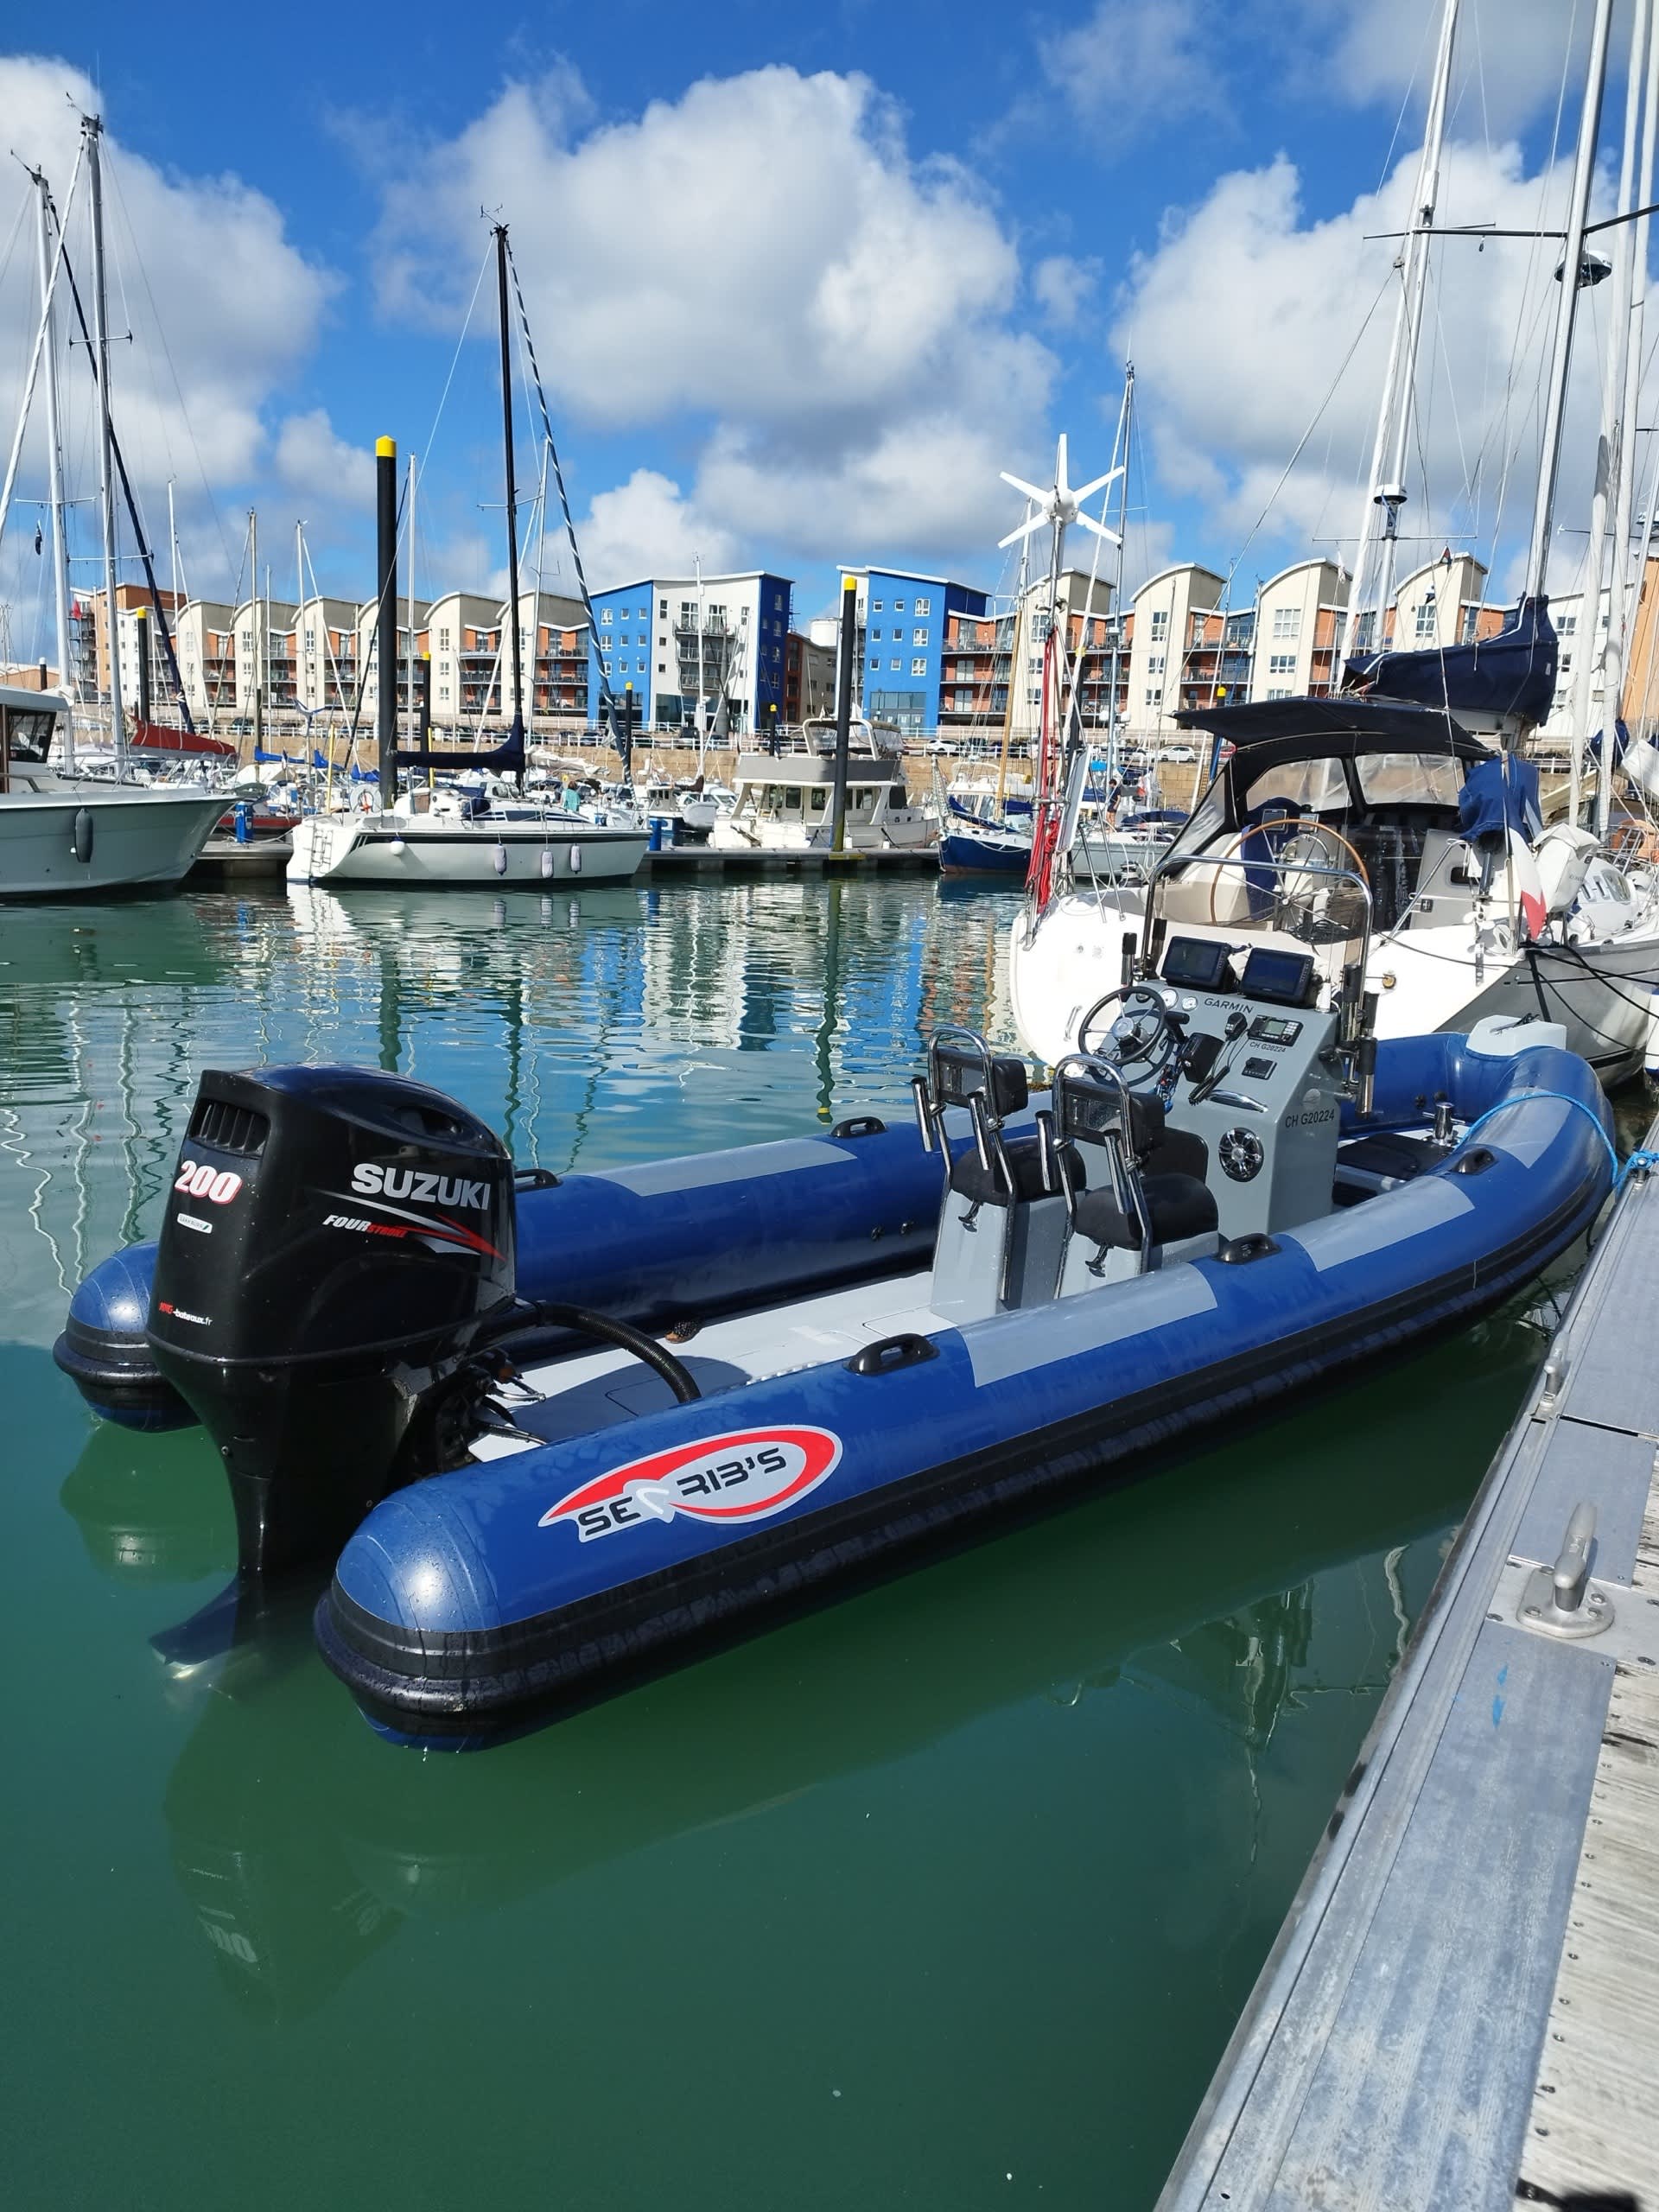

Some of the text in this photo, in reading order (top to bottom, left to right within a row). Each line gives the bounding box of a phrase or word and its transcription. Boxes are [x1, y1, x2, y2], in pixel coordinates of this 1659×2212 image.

[1204, 997, 1254, 1014] GARMIN
[1285, 1109, 1335, 1128] CH G20224
[175, 1160, 243, 1205] 200
[351, 1163, 491, 1211] SUZUKI
[677, 1447, 786, 1497] RIB'S
